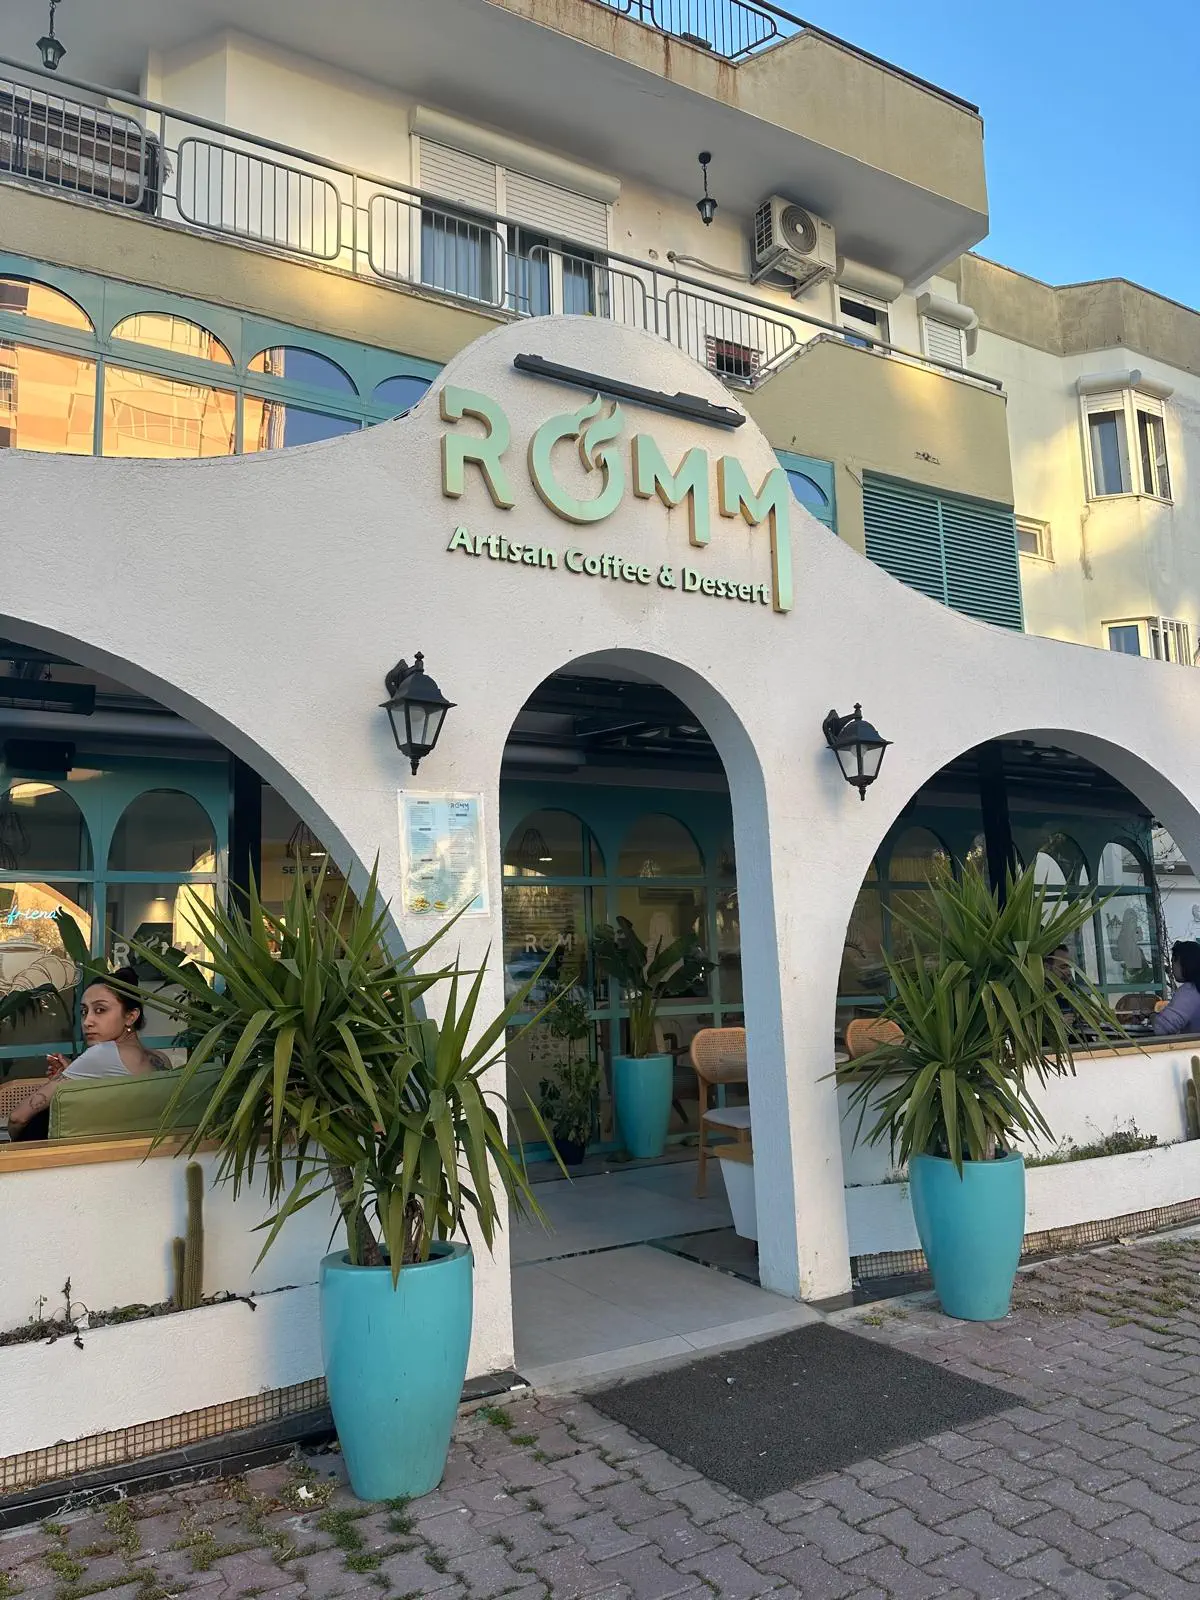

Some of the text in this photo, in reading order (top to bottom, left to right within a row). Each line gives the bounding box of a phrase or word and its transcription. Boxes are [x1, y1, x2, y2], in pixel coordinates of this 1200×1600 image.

[439, 384, 793, 613] ROMM
[447, 527, 770, 605] Artisan Coffee & Dessert
